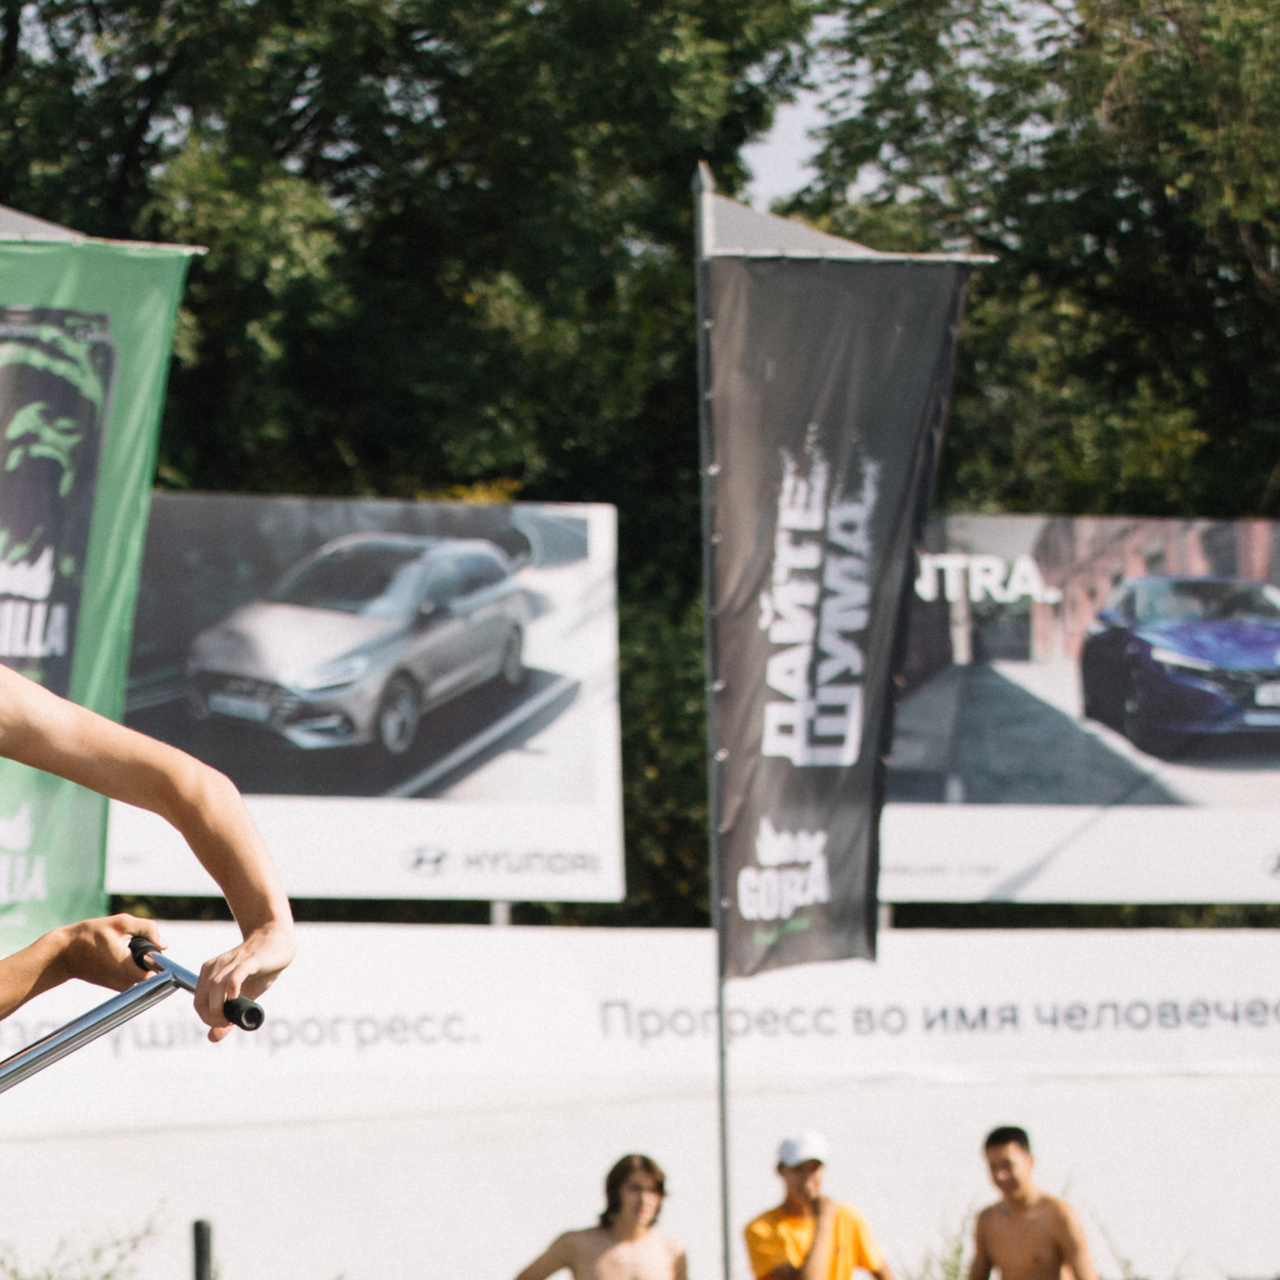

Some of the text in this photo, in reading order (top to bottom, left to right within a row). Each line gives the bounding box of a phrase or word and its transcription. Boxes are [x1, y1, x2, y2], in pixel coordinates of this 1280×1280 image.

[599, 995, 1280, 1047] Прогресс во имя человече
